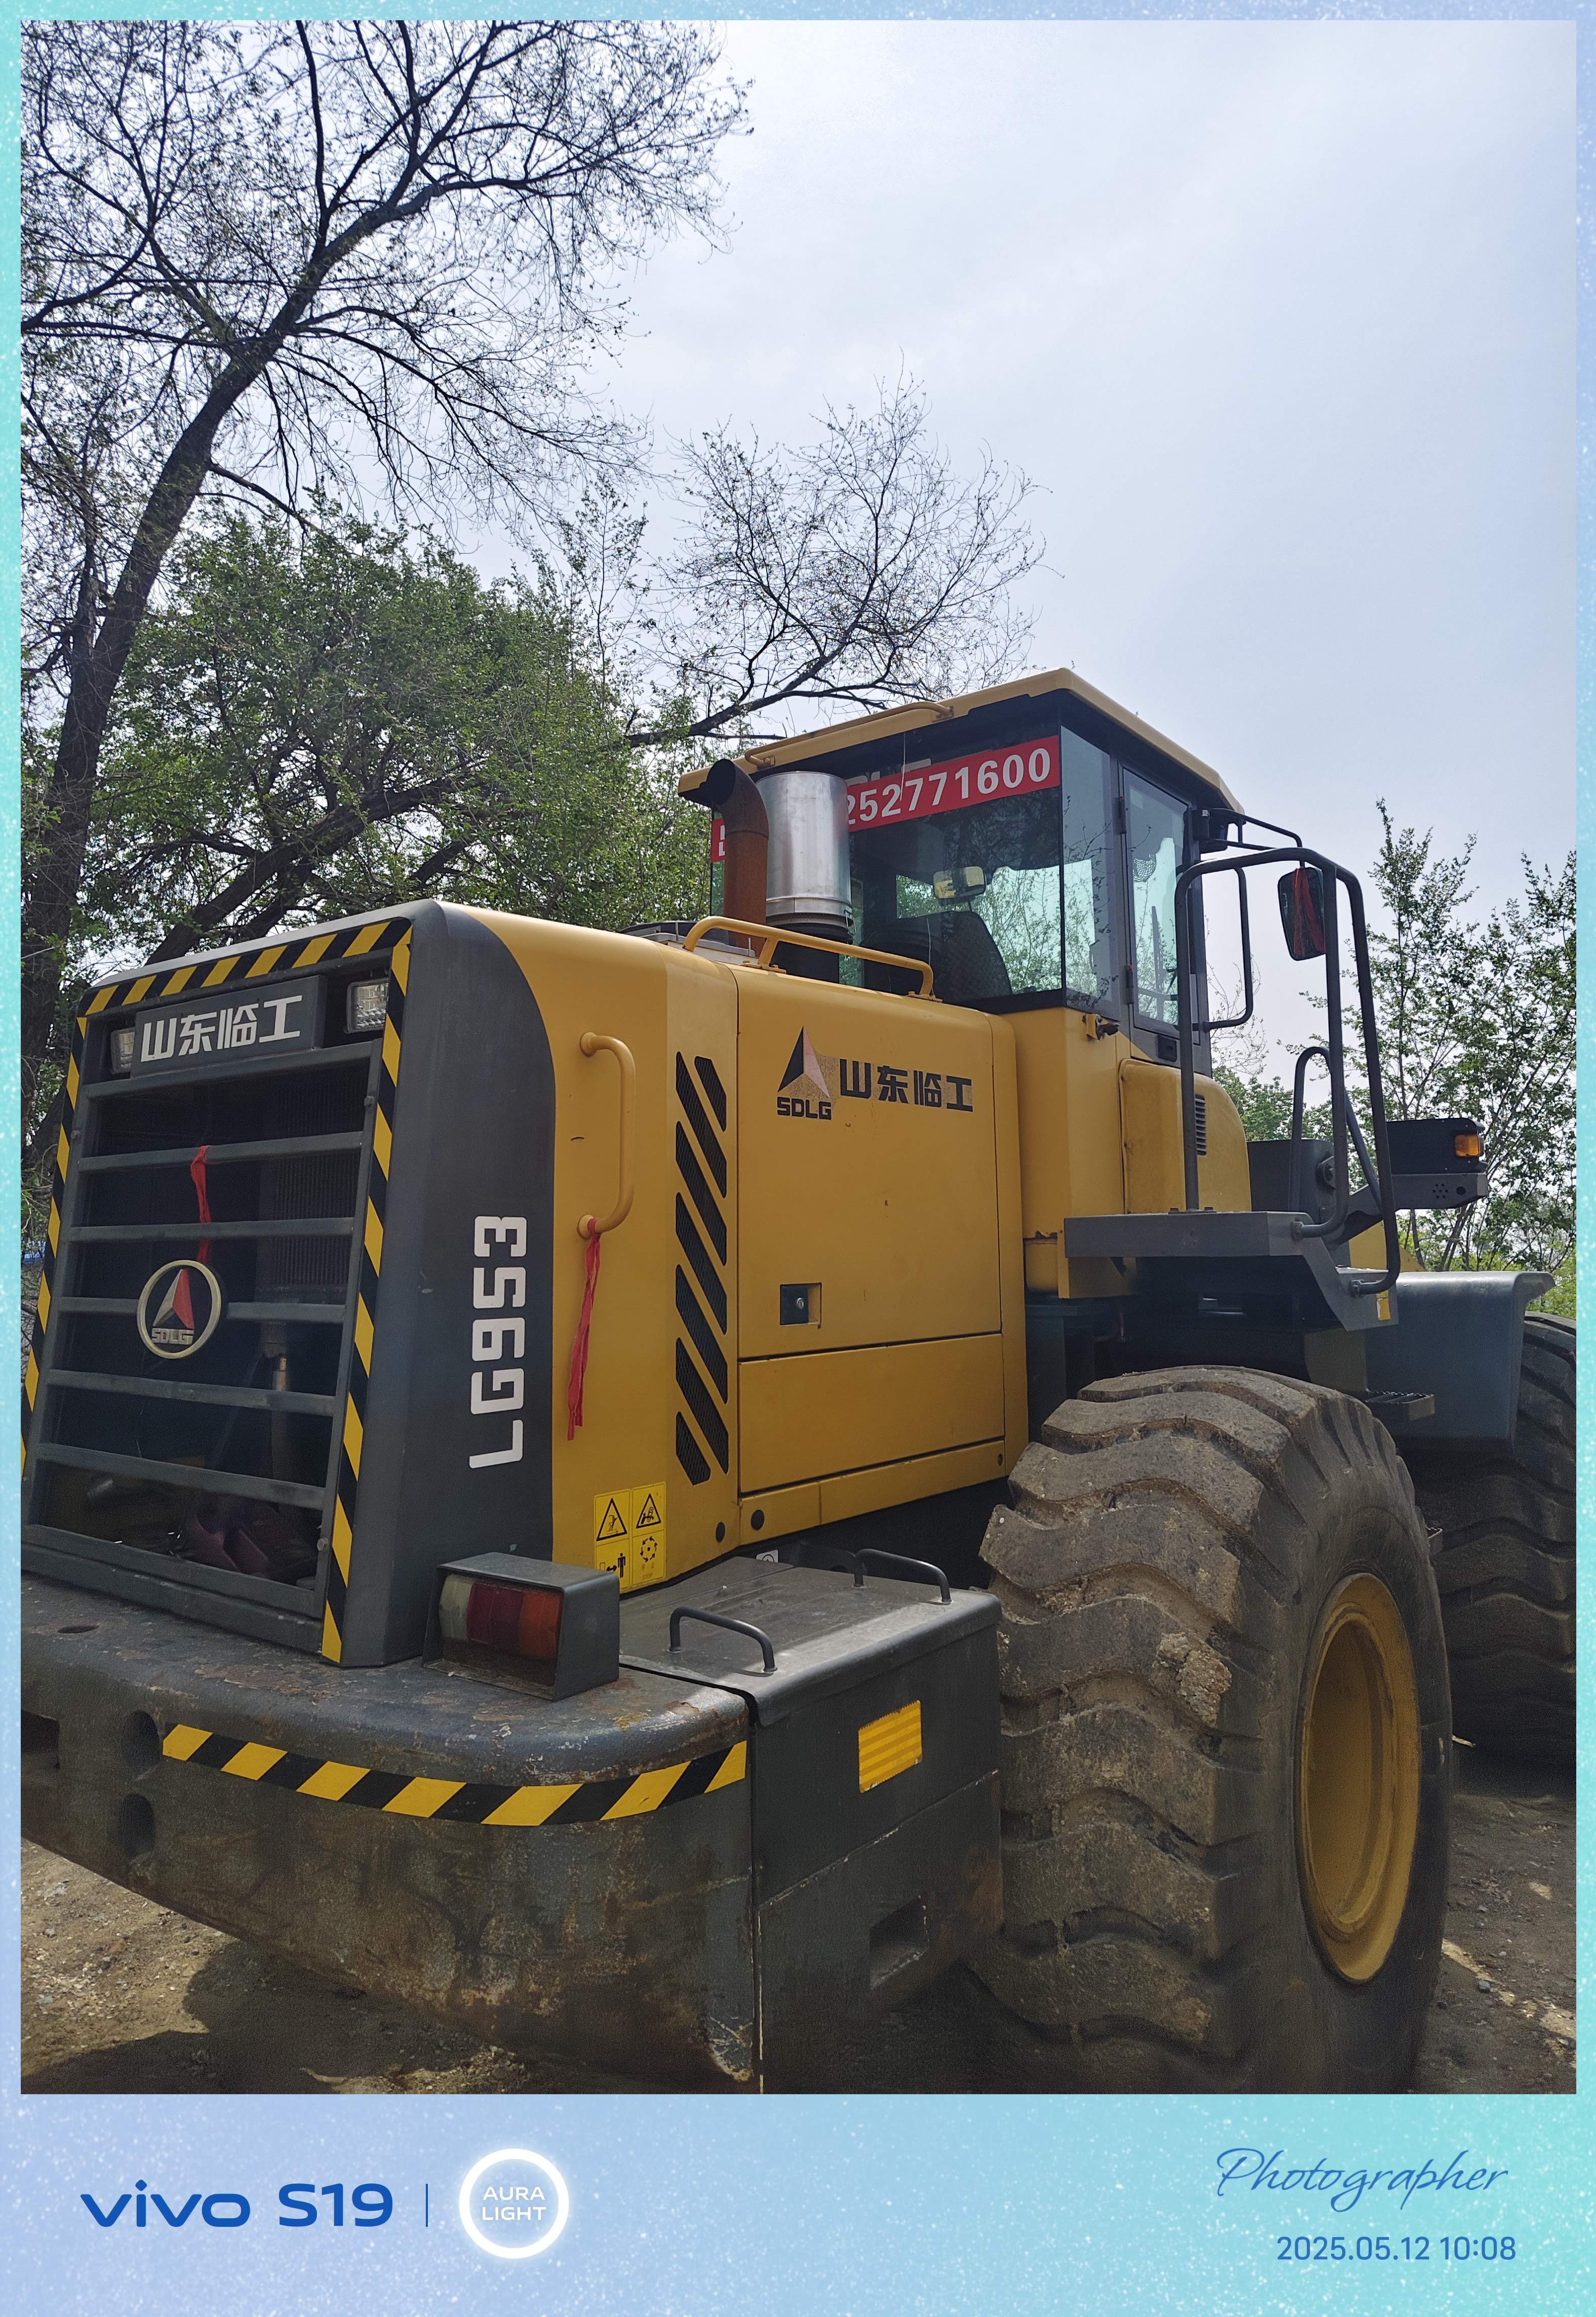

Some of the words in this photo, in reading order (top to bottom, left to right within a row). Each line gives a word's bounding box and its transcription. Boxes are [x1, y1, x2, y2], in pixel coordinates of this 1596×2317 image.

[141, 995, 302, 1062] 山东临工
[777, 1097, 831, 1120] SDLG
[840, 1058, 973, 1112] 山东临工
[152, 1328, 194, 1345] SDLG
[469, 1216, 527, 1468] LG953
